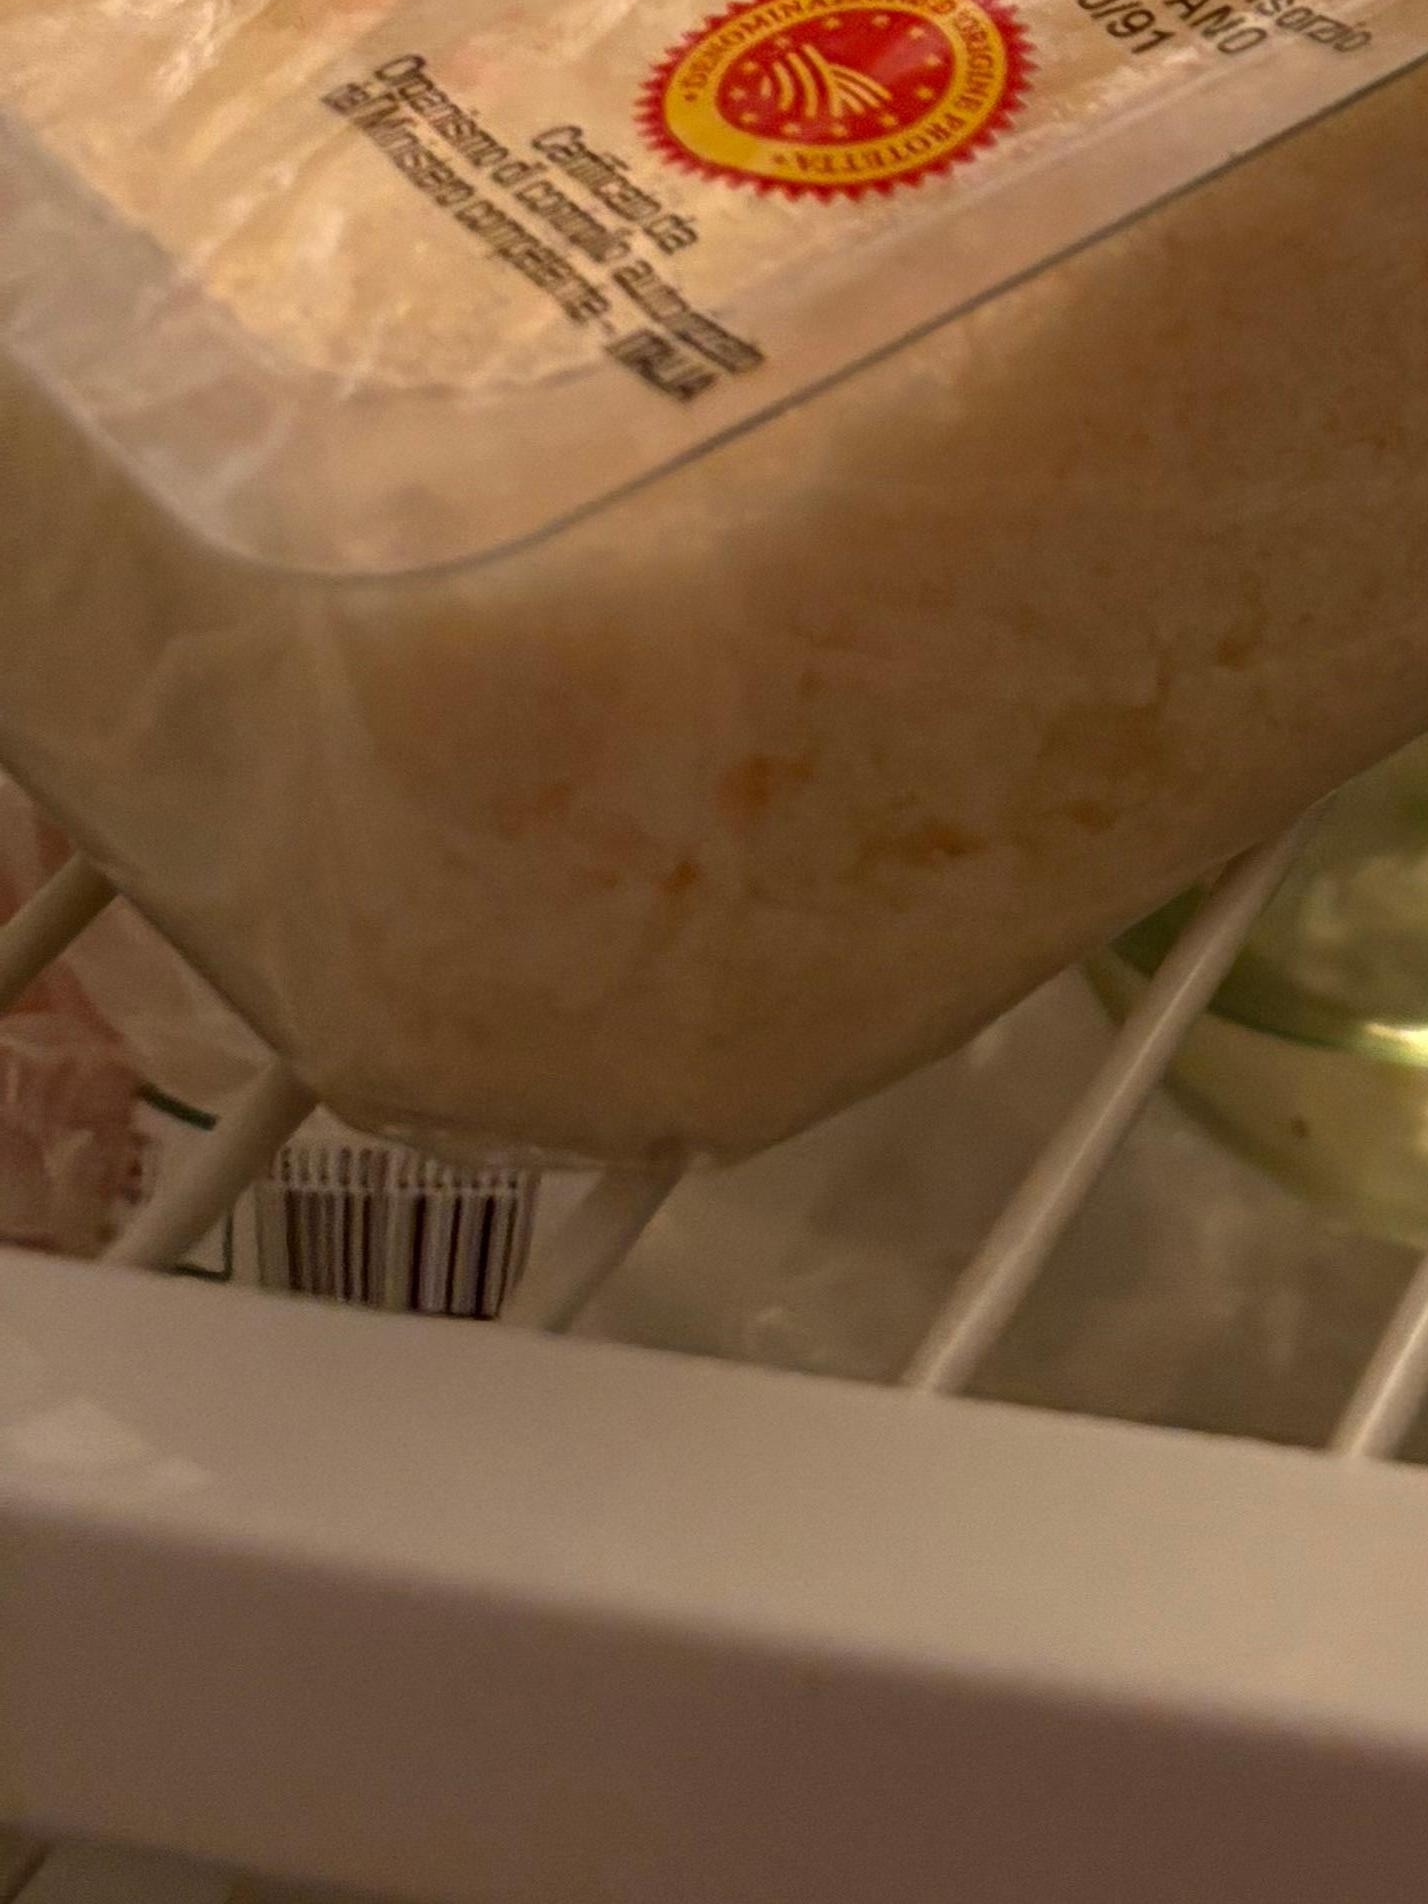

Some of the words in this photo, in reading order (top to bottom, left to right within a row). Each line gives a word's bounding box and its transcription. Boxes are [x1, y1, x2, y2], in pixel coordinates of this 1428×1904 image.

[374, 53, 509, 168] Organismo
[796, 112, 967, 173] PROTETTA
[531, 125, 662, 221] Certificato
[642, 212, 698, 255] da
